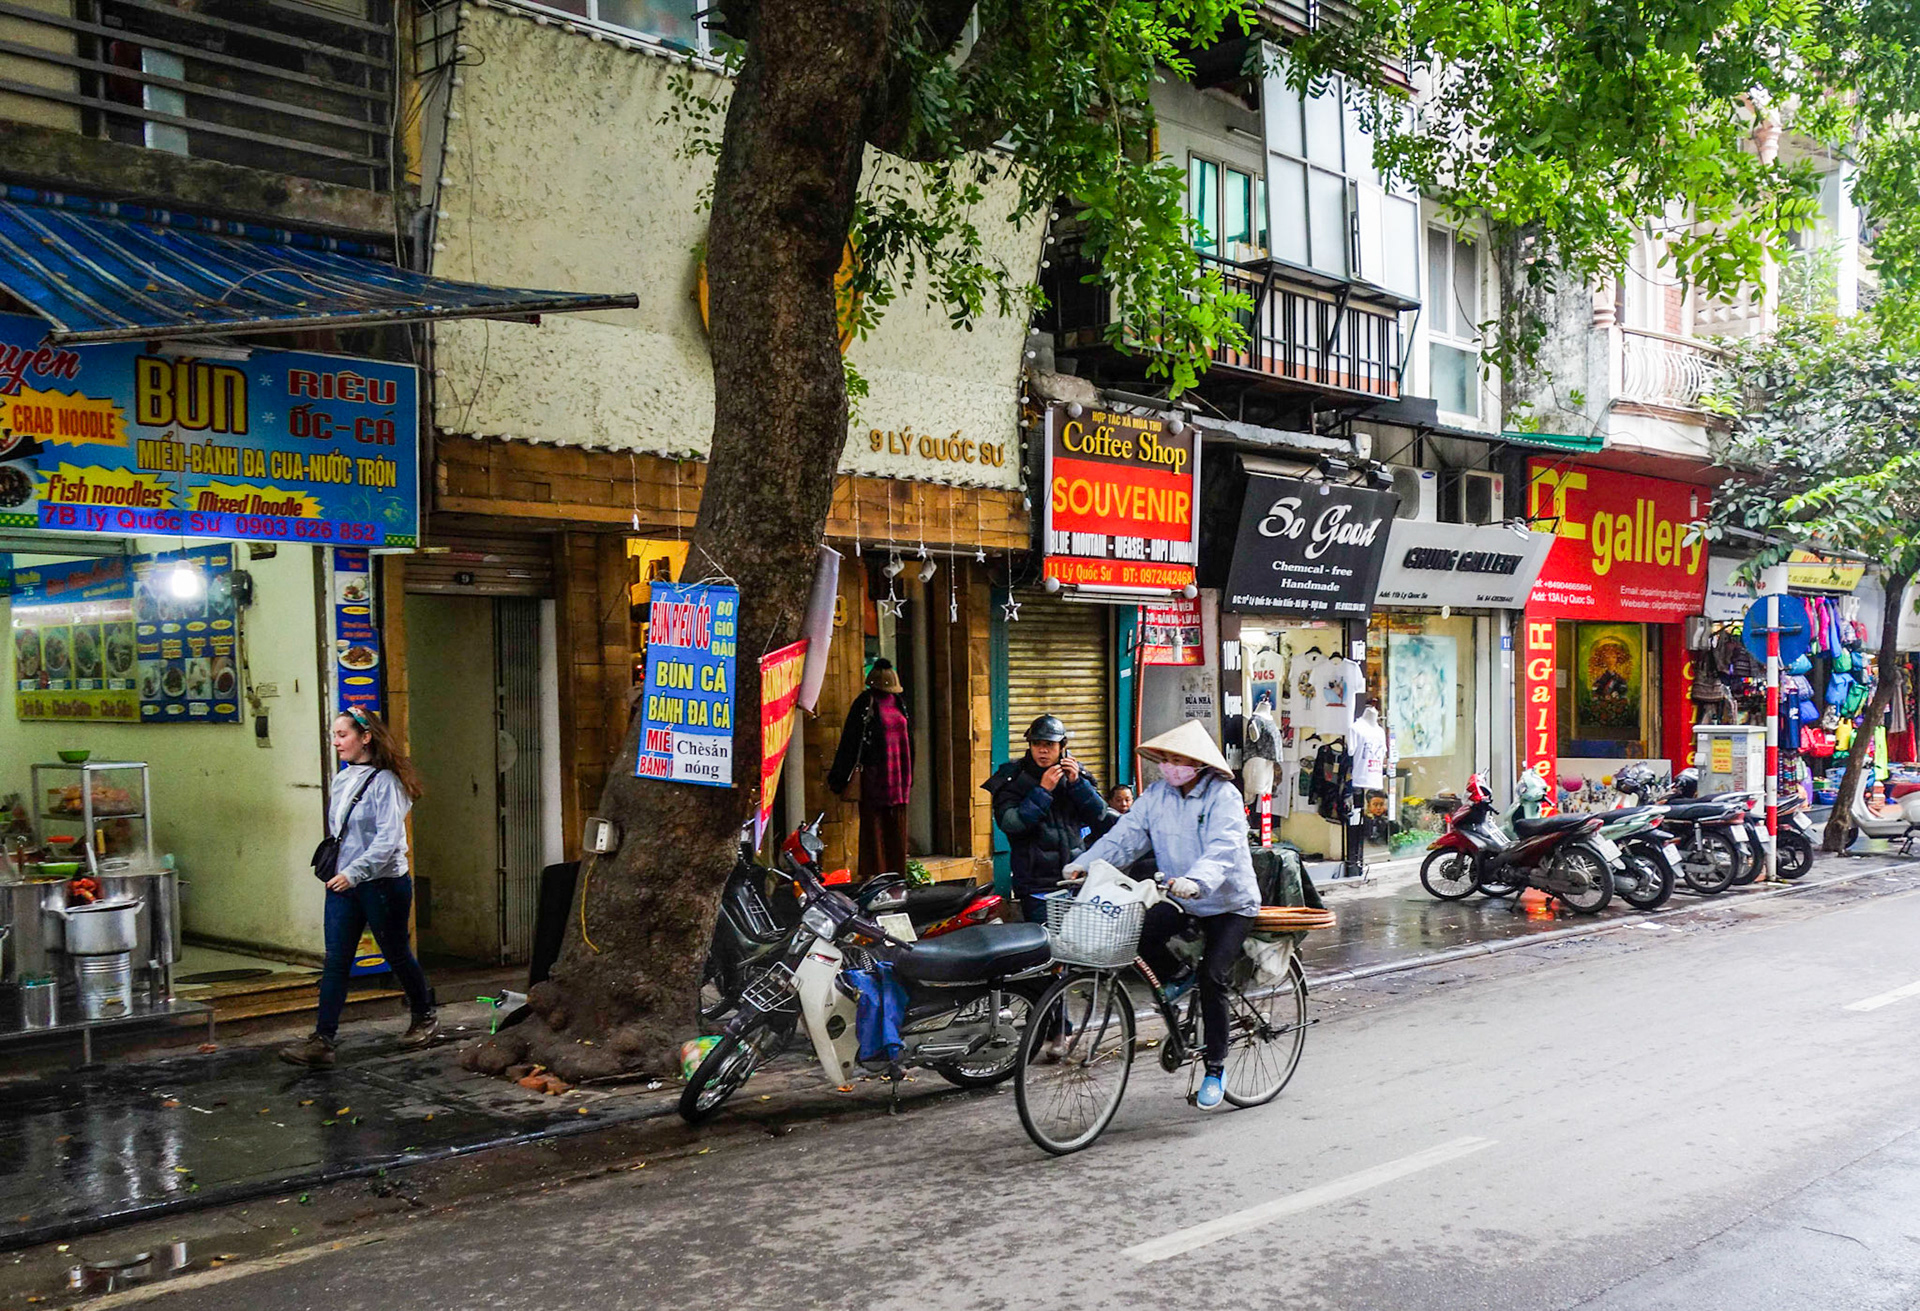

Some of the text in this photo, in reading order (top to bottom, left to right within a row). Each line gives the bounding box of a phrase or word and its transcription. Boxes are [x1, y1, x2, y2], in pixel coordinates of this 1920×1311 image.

[288, 370, 397, 405] RIÊU
[13, 404, 116, 440] CRAB NOODLE
[289, 403, 397, 446] ỐC-CÁ
[869, 425, 1006, 467] 9 LÝ QUỐC SƯ
[1062, 420, 1187, 475] Coffee Shop
[48, 474, 163, 507] Fish noodles
[356, 455, 397, 492] TRỘN
[197, 490, 249, 514] Mixed
[1052, 476, 1189, 524] SOUVENIR
[42, 505, 76, 525] 7B
[116, 509, 182, 530] Quốc
[190, 512, 222, 532] Sư
[236, 517, 287, 536] 0903
[295, 520, 332, 538] 626
[339, 523, 375, 541] 852
[1258, 496, 1383, 560] So Good
[1592, 499, 1704, 576] gallery
[1076, 562, 1098, 581] Quốc
[1272, 560, 1324, 575] Chemical
[1331, 566, 1353, 577] free
[1456, 551, 1524, 575] GALLERY
[1280, 578, 1340, 592] Handmade
[1561, 593, 1568, 605] Ly
[1569, 594, 1585, 604] Quoc
[1586, 595, 1595, 605] Su
[695, 590, 711, 650] ỐC
[1620, 599, 1651, 608] Website:
[655, 657, 727, 694] BÚN CÁ
[1253, 669, 1275, 681] PUGS
[648, 692, 731, 729] BÁNH ĐA CÁ
[646, 723, 674, 753] MIẾ
[639, 753, 668, 777] BÁNH
[685, 760, 720, 779] nóng
